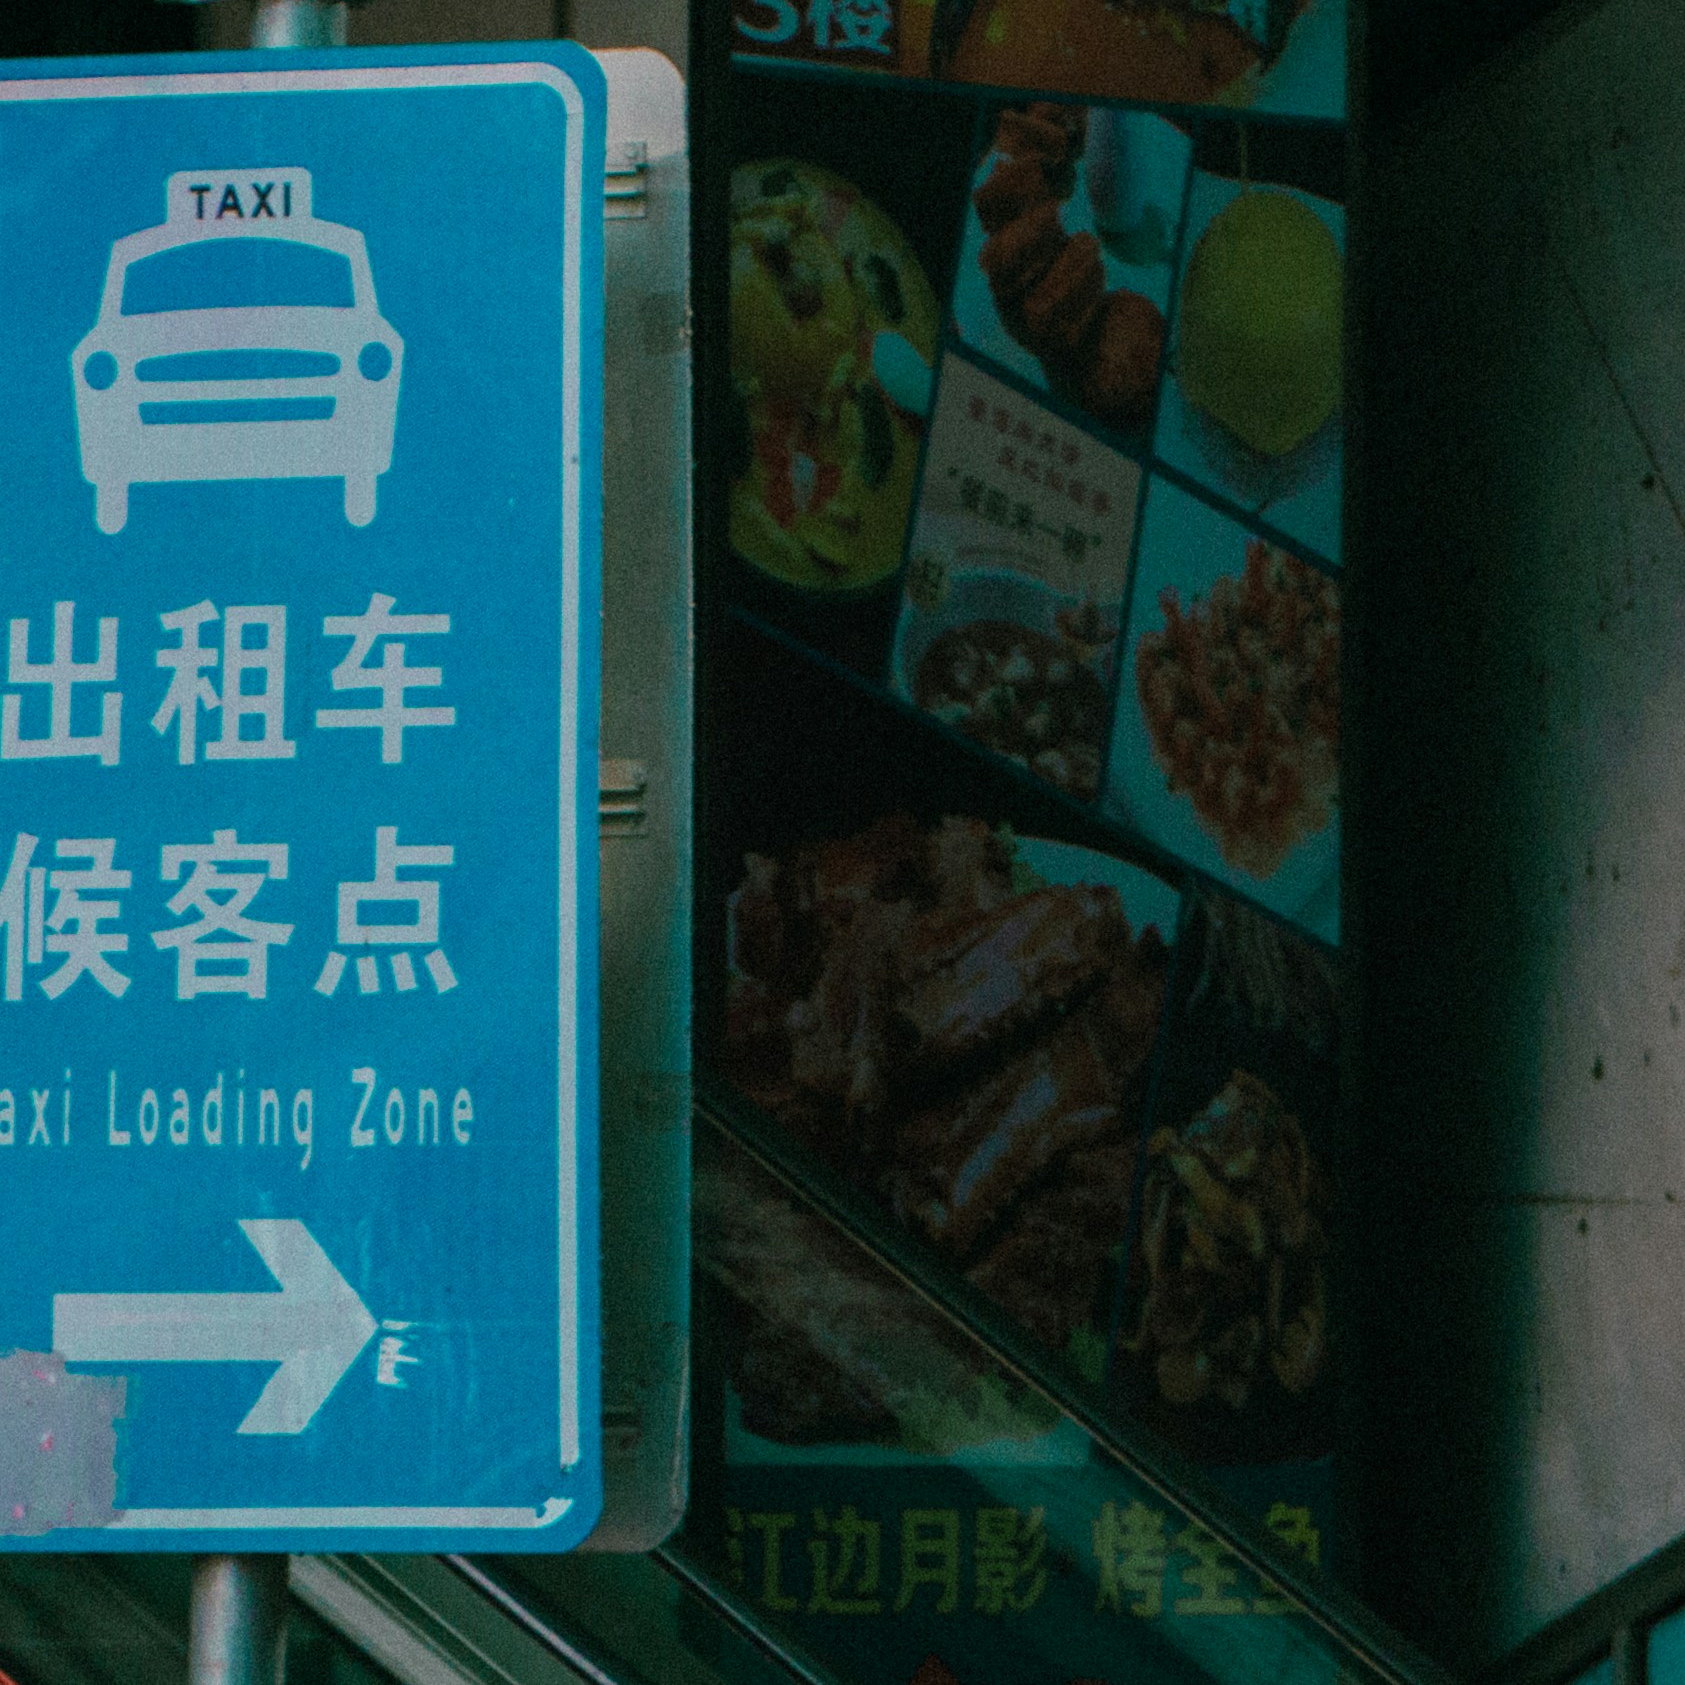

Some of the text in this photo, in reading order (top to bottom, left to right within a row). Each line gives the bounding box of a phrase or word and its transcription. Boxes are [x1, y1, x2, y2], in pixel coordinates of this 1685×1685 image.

[188, 181, 293, 221] TAXI
[0, 591, 458, 768] 出租车
[0, 825, 459, 1001] 候客点
[0, 1066, 475, 1172] axi Loading Zone
[724, 1504, 1048, 1617] 江边月影
